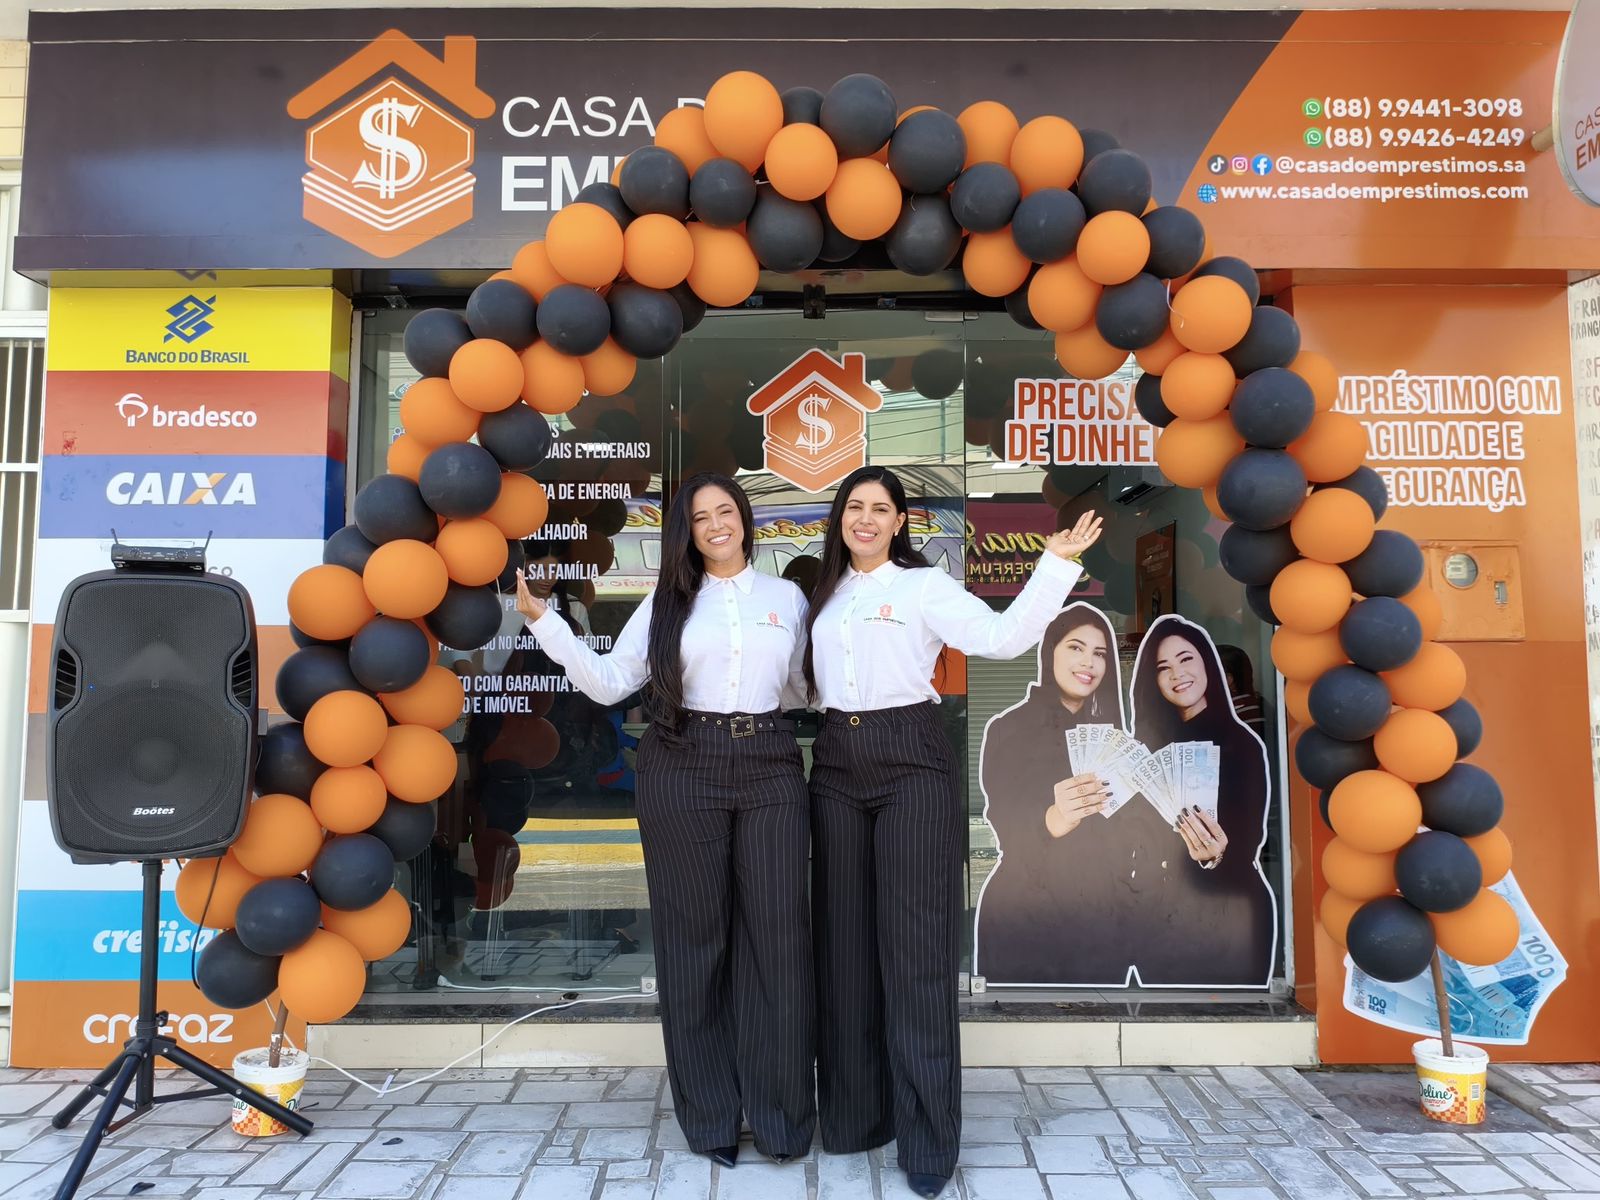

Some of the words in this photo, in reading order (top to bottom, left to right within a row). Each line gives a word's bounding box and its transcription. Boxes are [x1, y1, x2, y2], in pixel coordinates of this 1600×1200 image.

[502, 96, 656, 137] CASA
[1323, 97, 1370, 119] (88)
[1377, 98, 1523, 118] 9.9441-3098
[1325, 126, 1372, 149] (88)
[1379, 127, 1525, 148] 9.9426-4249
[1275, 156, 1526, 176] @casadoemprestimos.sa
[1220, 183, 1529, 202] www.casadoemprestimos.com
[178, 352, 198, 363] DO
[1500, 379, 1559, 411] COM
[152, 404, 257, 427] bradesco
[1008, 424, 1047, 462] DE
[1506, 425, 1522, 456] E
[106, 472, 256, 505] CAIXA
[559, 484, 575, 499] DE
[578, 484, 631, 499] ENERGIA
[549, 561, 599, 580] FAMÍLIA
[499, 635, 511, 650] NO
[474, 676, 501, 692] COM
[506, 676, 569, 692] GARANTIA
[473, 697, 481, 713] E
[485, 693, 532, 713] IMÓVEL
[1521, 935, 1554, 966] 100
[1367, 993, 1387, 1009] 100
